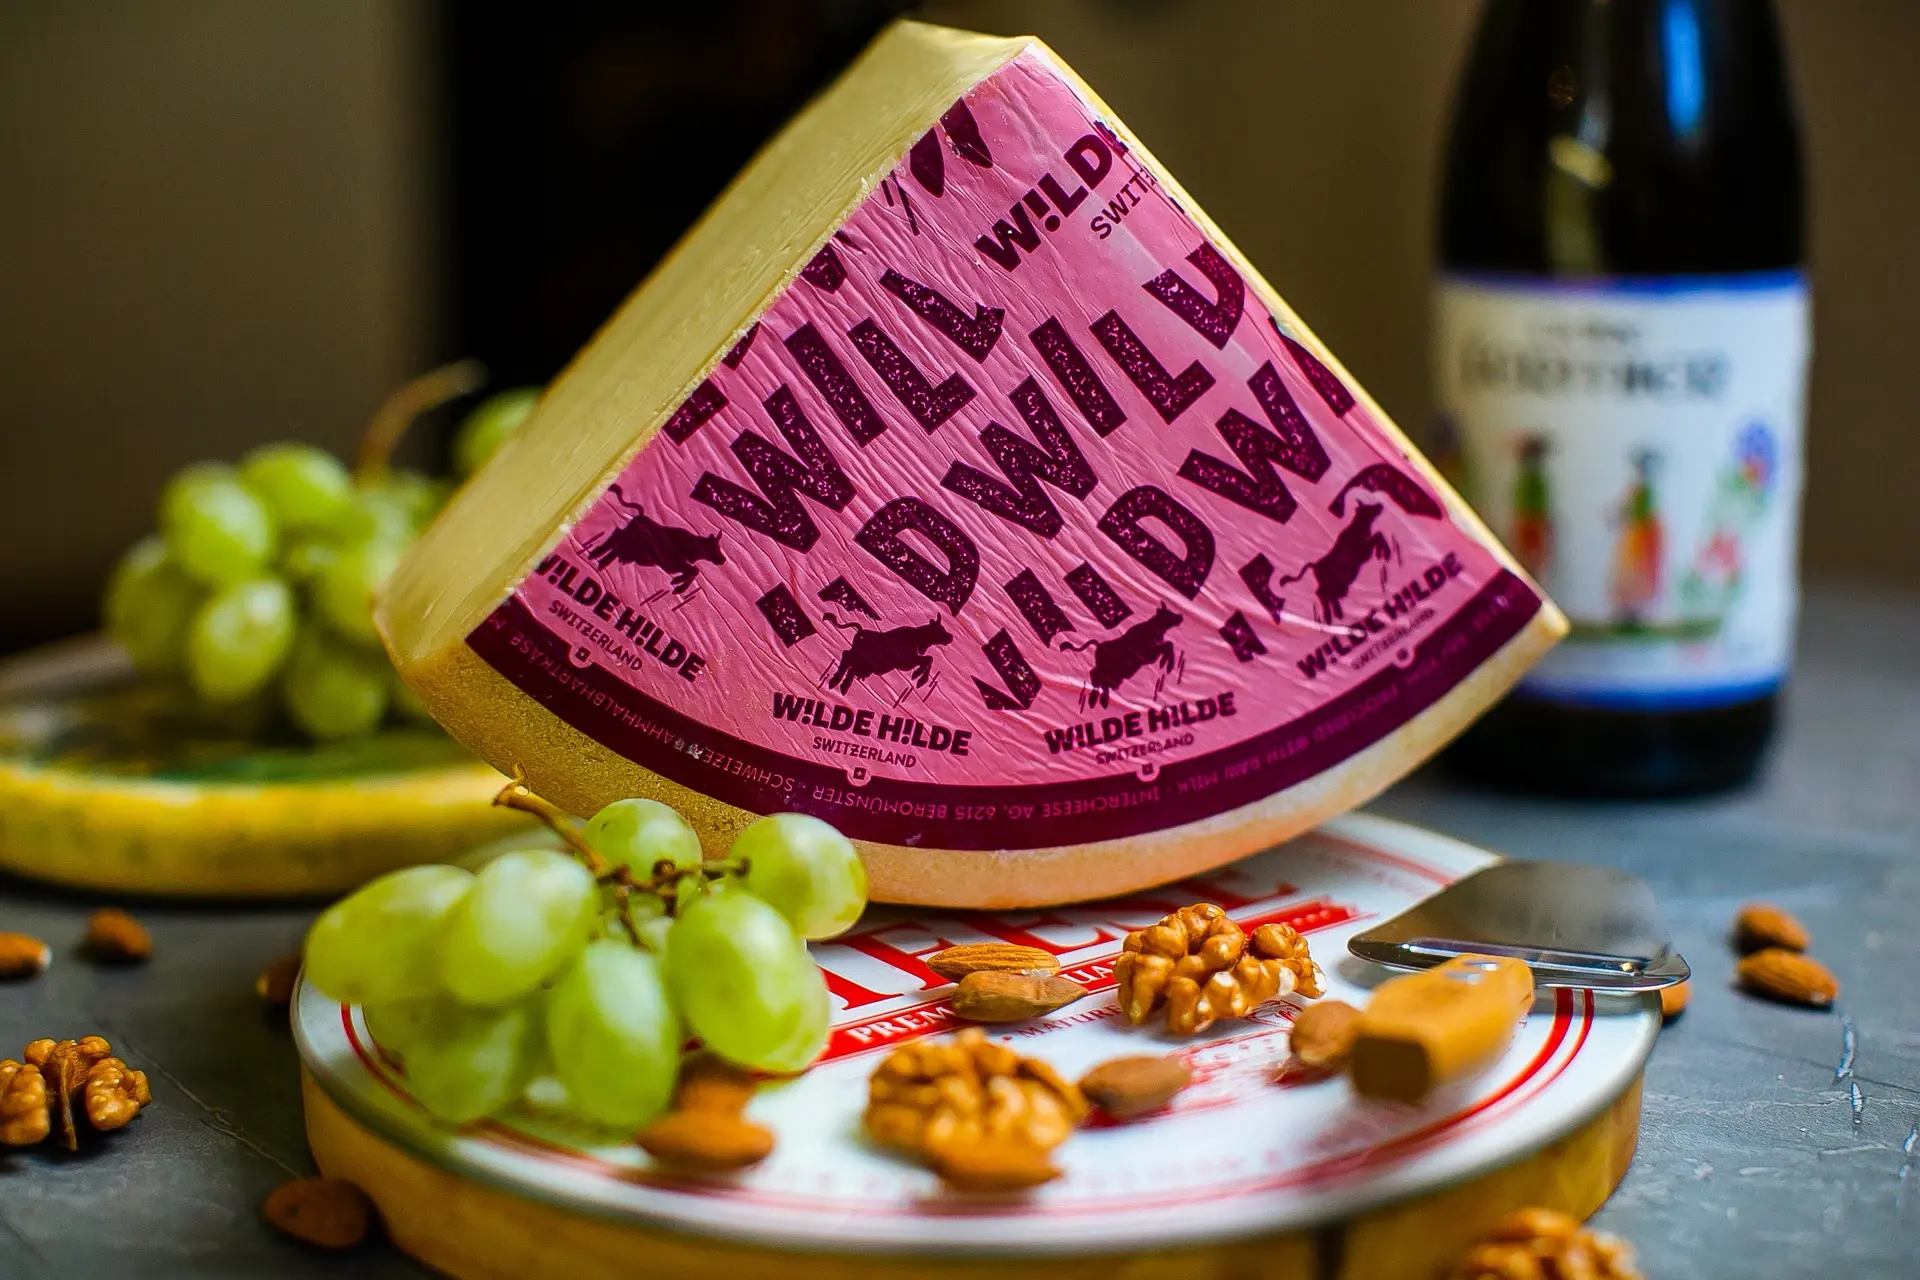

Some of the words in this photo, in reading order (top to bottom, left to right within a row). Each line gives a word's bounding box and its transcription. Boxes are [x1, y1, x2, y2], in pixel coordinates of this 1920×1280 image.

[549, 600, 643, 671] SWITZERLAND
[812, 736, 917, 768] SWITZERLAND
[1095, 732, 1195, 765] SWITZERLAND
[812, 784, 948, 820] BEROMÜNSTER
[954, 804, 997, 821] 6215
[1041, 785, 1160, 818] INTERCHEESE
[844, 1004, 955, 1044] PREM
